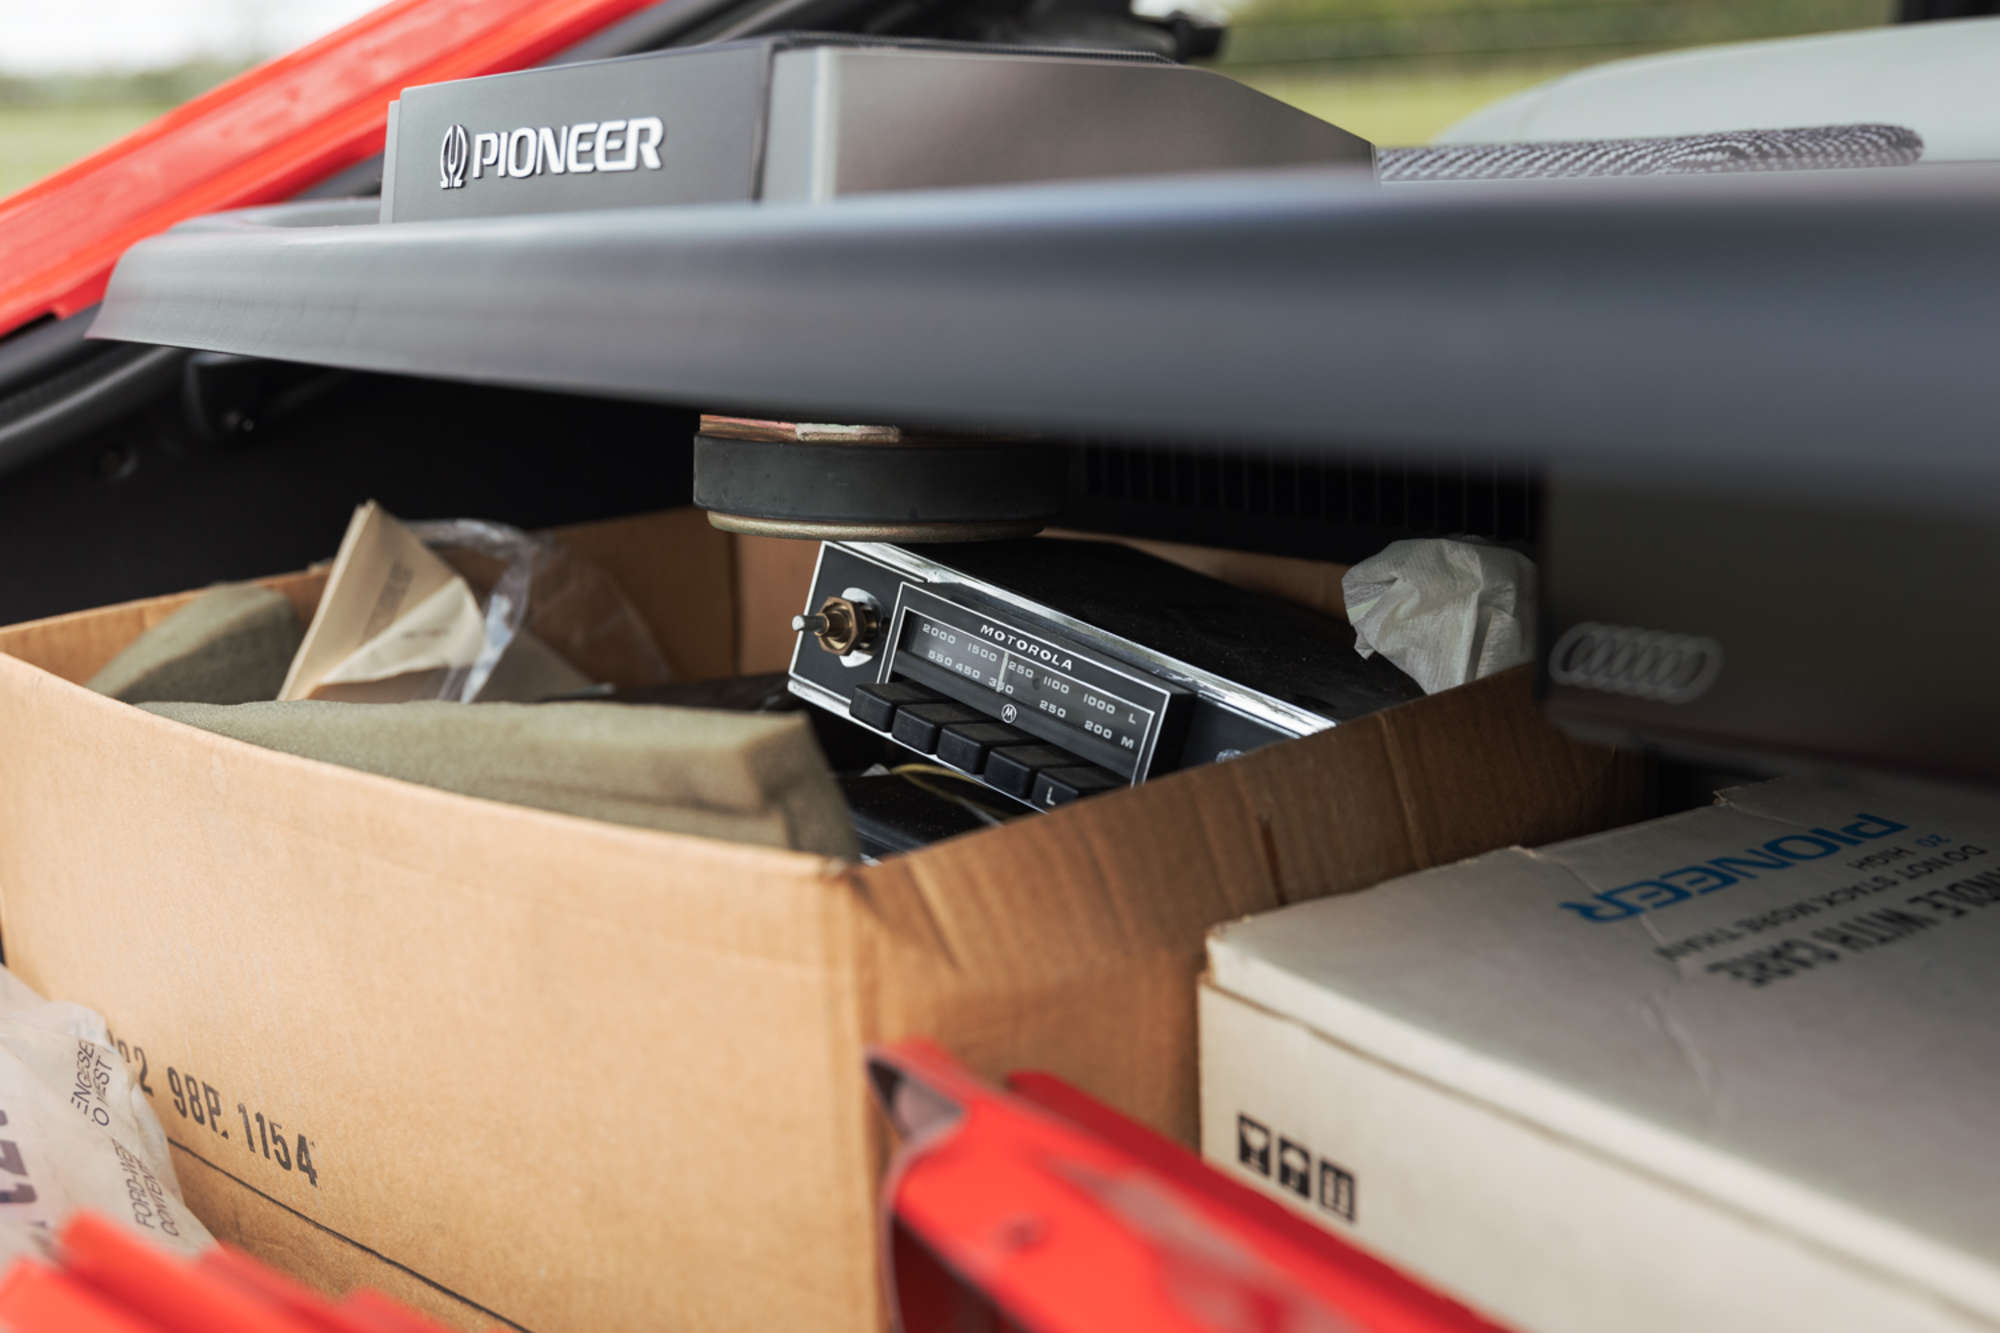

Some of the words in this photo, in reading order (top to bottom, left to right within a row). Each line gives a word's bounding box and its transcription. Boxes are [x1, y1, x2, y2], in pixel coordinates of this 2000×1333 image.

[472, 116, 664, 179] PIONEER
[980, 623, 1073, 671] MOTOROLA
[922, 622, 957, 645] 2000
[967, 641, 998, 663] 1500
[1007, 660, 1034, 679] 250
[1043, 675, 1070, 695] 1100
[1083, 692, 1116, 715] 1000
[1128, 713, 1137, 725] L
[927, 650, 953, 667] 550
[955, 662, 981, 680] 450
[1039, 699, 1067, 719] 250
[1084, 719, 1113, 740] 200
[1121, 735, 1135, 749] M
[1046, 786, 1056, 806] L
[1847, 846, 1915, 872] HIGH
[1914, 833, 1951, 848] 20
[1944, 843, 1989, 865] DO
[1558, 813, 1909, 922] PIONEER
[1817, 873, 1899, 908] STACK
[1895, 856, 1951, 880] NOT
[1906, 866, 2000, 919] NDLE
[237, 1102, 318, 1188] 1154
